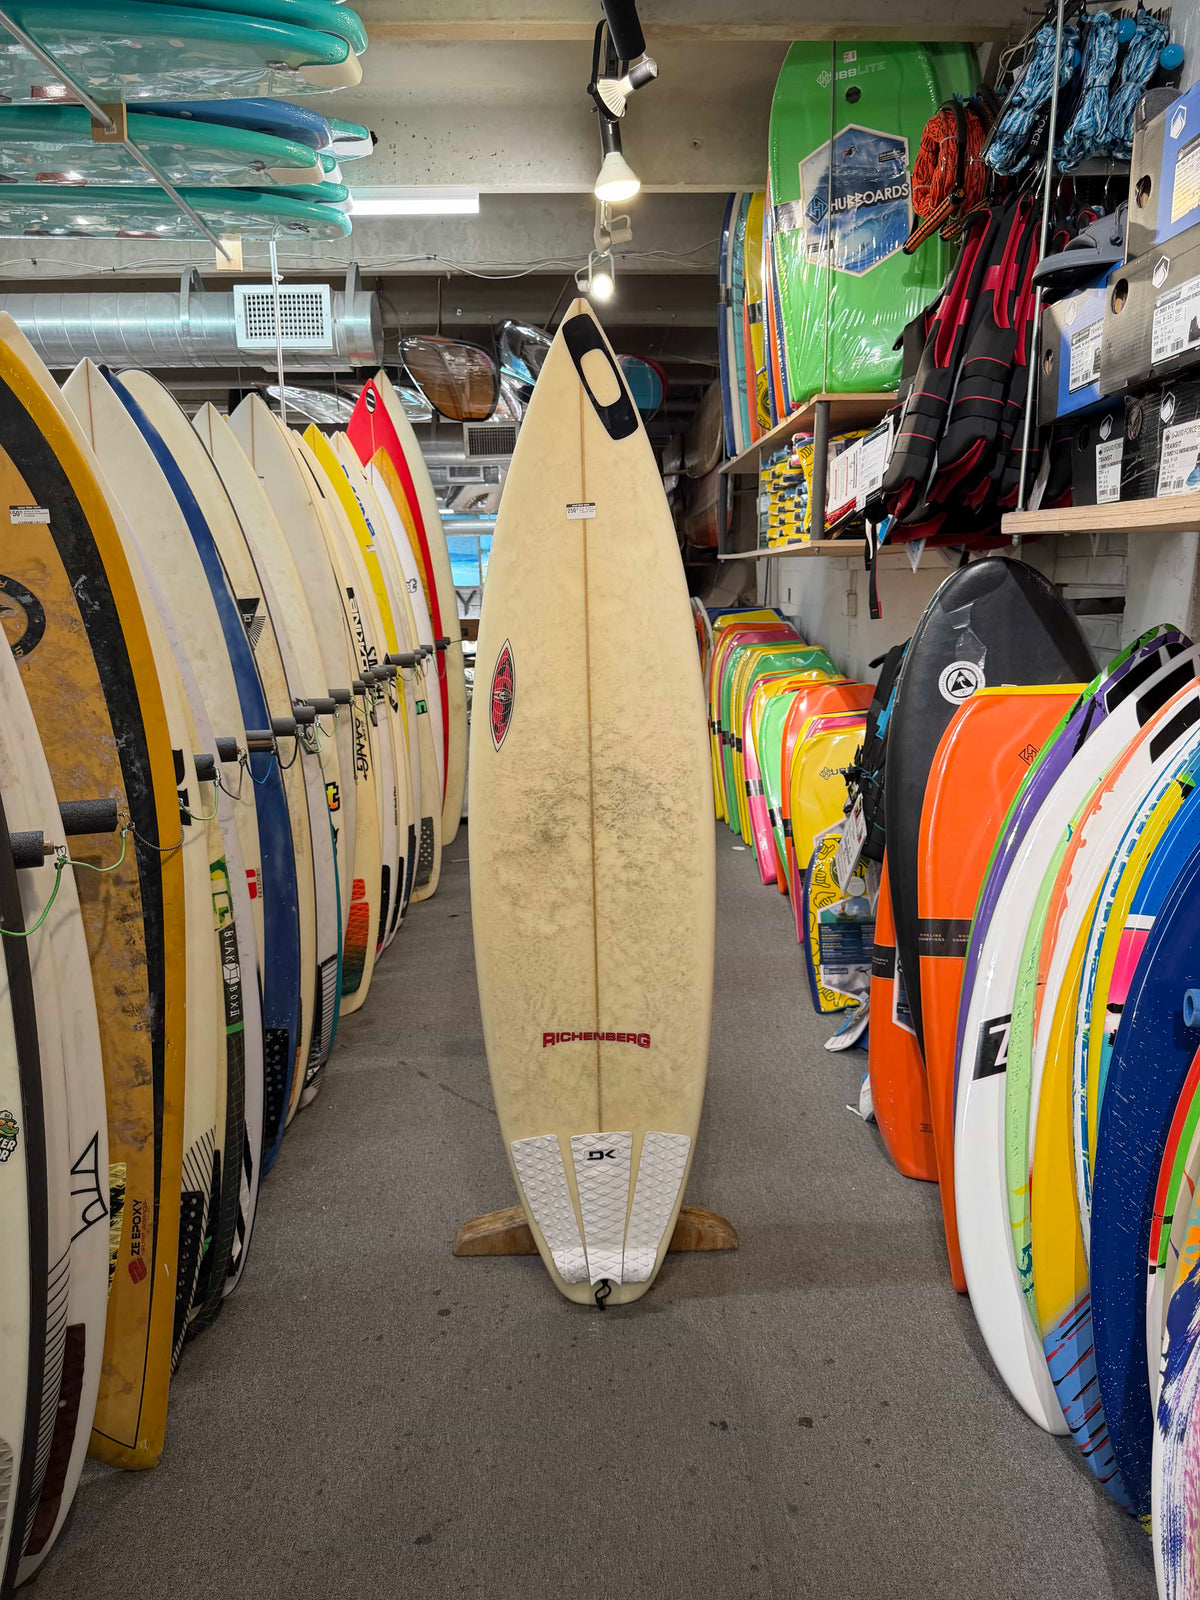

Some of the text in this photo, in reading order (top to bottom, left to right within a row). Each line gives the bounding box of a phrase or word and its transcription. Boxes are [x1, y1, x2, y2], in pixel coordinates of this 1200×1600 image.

[223, 930, 236, 963] BLAK
[542, 1032, 651, 1049] RICHENBERG
[131, 1199, 142, 1256] ZE EPOXY
